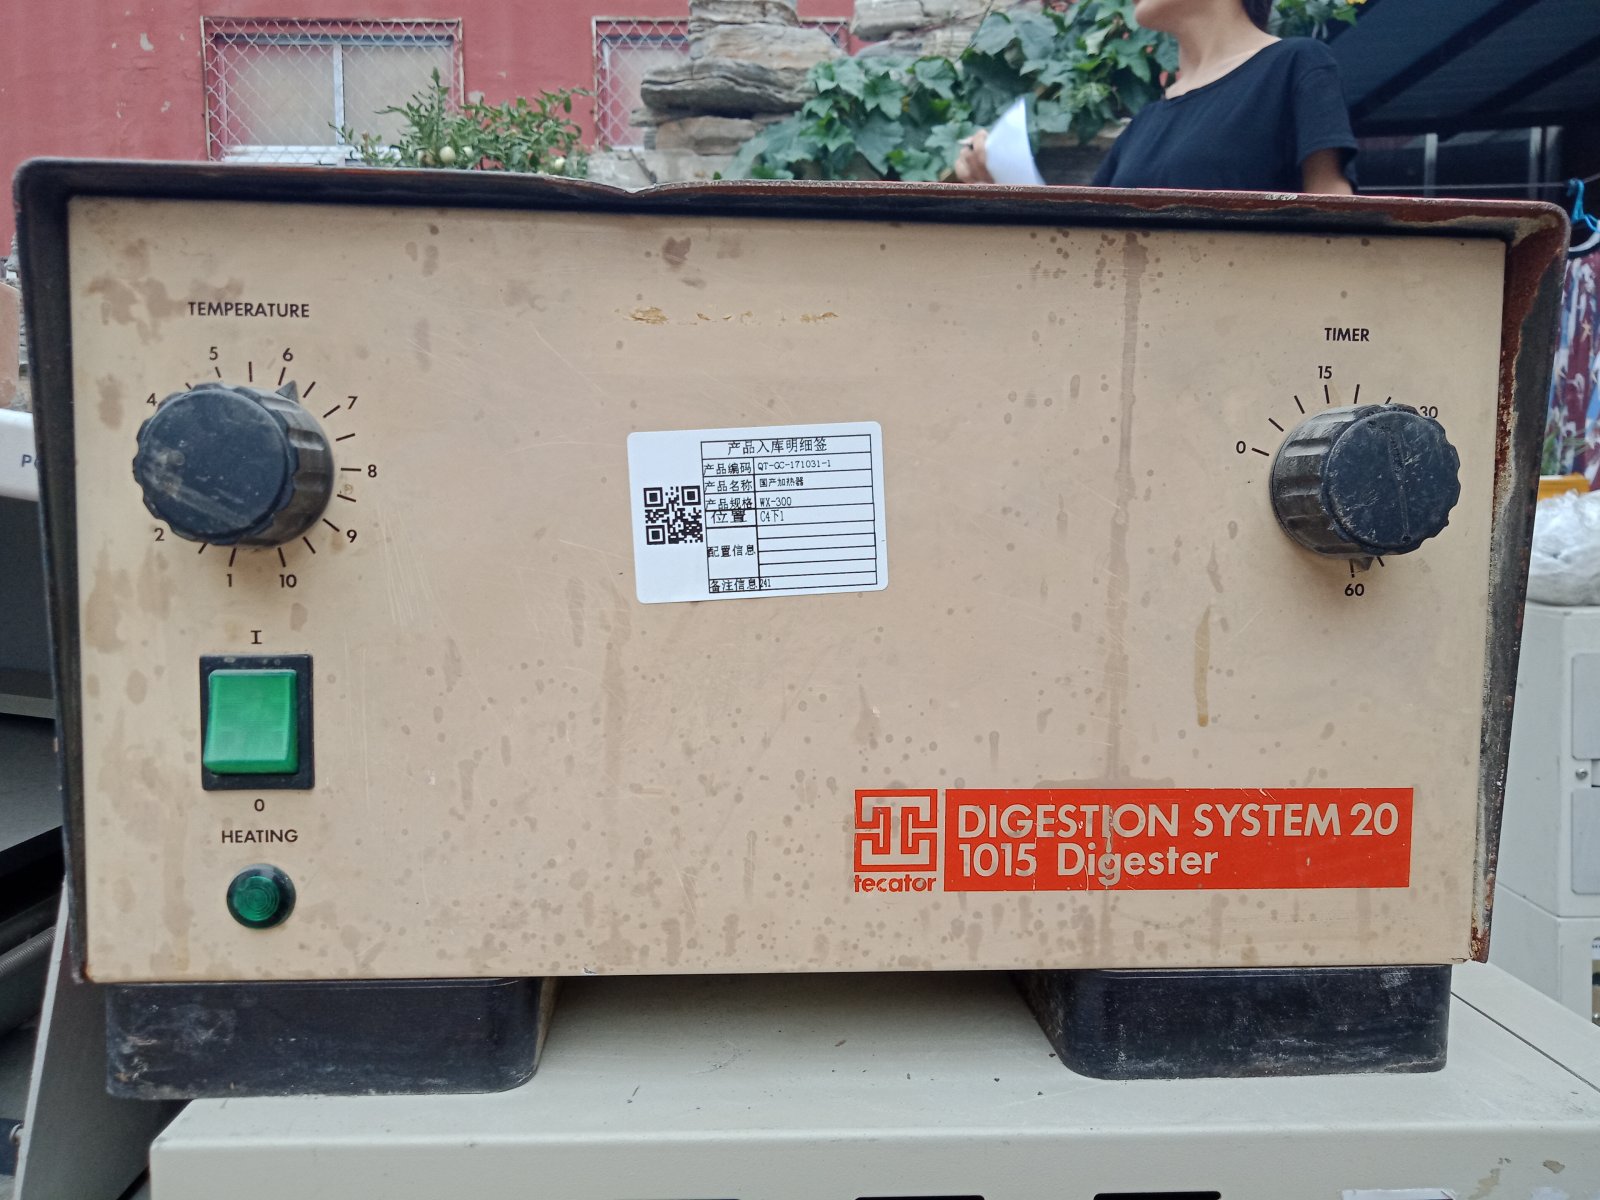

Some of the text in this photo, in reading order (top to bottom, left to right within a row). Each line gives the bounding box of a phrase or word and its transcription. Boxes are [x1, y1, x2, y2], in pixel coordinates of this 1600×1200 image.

[189, 301, 310, 319] TEMPERATURE
[1324, 327, 1370, 342] TIMER
[209, 347, 218, 361] 5
[283, 349, 293, 362] 6
[1318, 366, 1333, 379] 15
[147, 393, 157, 406] 4
[347, 396, 358, 410] 7
[1420, 406, 1438, 419] 30
[728, 437, 827, 455] 产品入库明细签
[1236, 440, 1247, 454] 0
[367, 465, 377, 478] 8
[703, 462, 752, 475] 产品编码
[704, 479, 753, 493] 产品名称
[759, 477, 804, 488] 国产加热器
[705, 498, 753, 510] 产品规格
[759, 496, 792, 507] WX-300
[154, 528, 165, 542] 2
[347, 529, 357, 543] 9
[707, 544, 756, 558] 配置信息
[227, 574, 233, 587] 1
[280, 574, 297, 588] 10
[709, 578, 758, 593] 备注信息
[1344, 583, 1365, 597] 60
[957, 803, 1399, 839] DIGESTION SYSTEM 20
[221, 829, 298, 844] HEATING
[960, 842, 1219, 886] 1015 Digester
[853, 874, 937, 893] tecator
